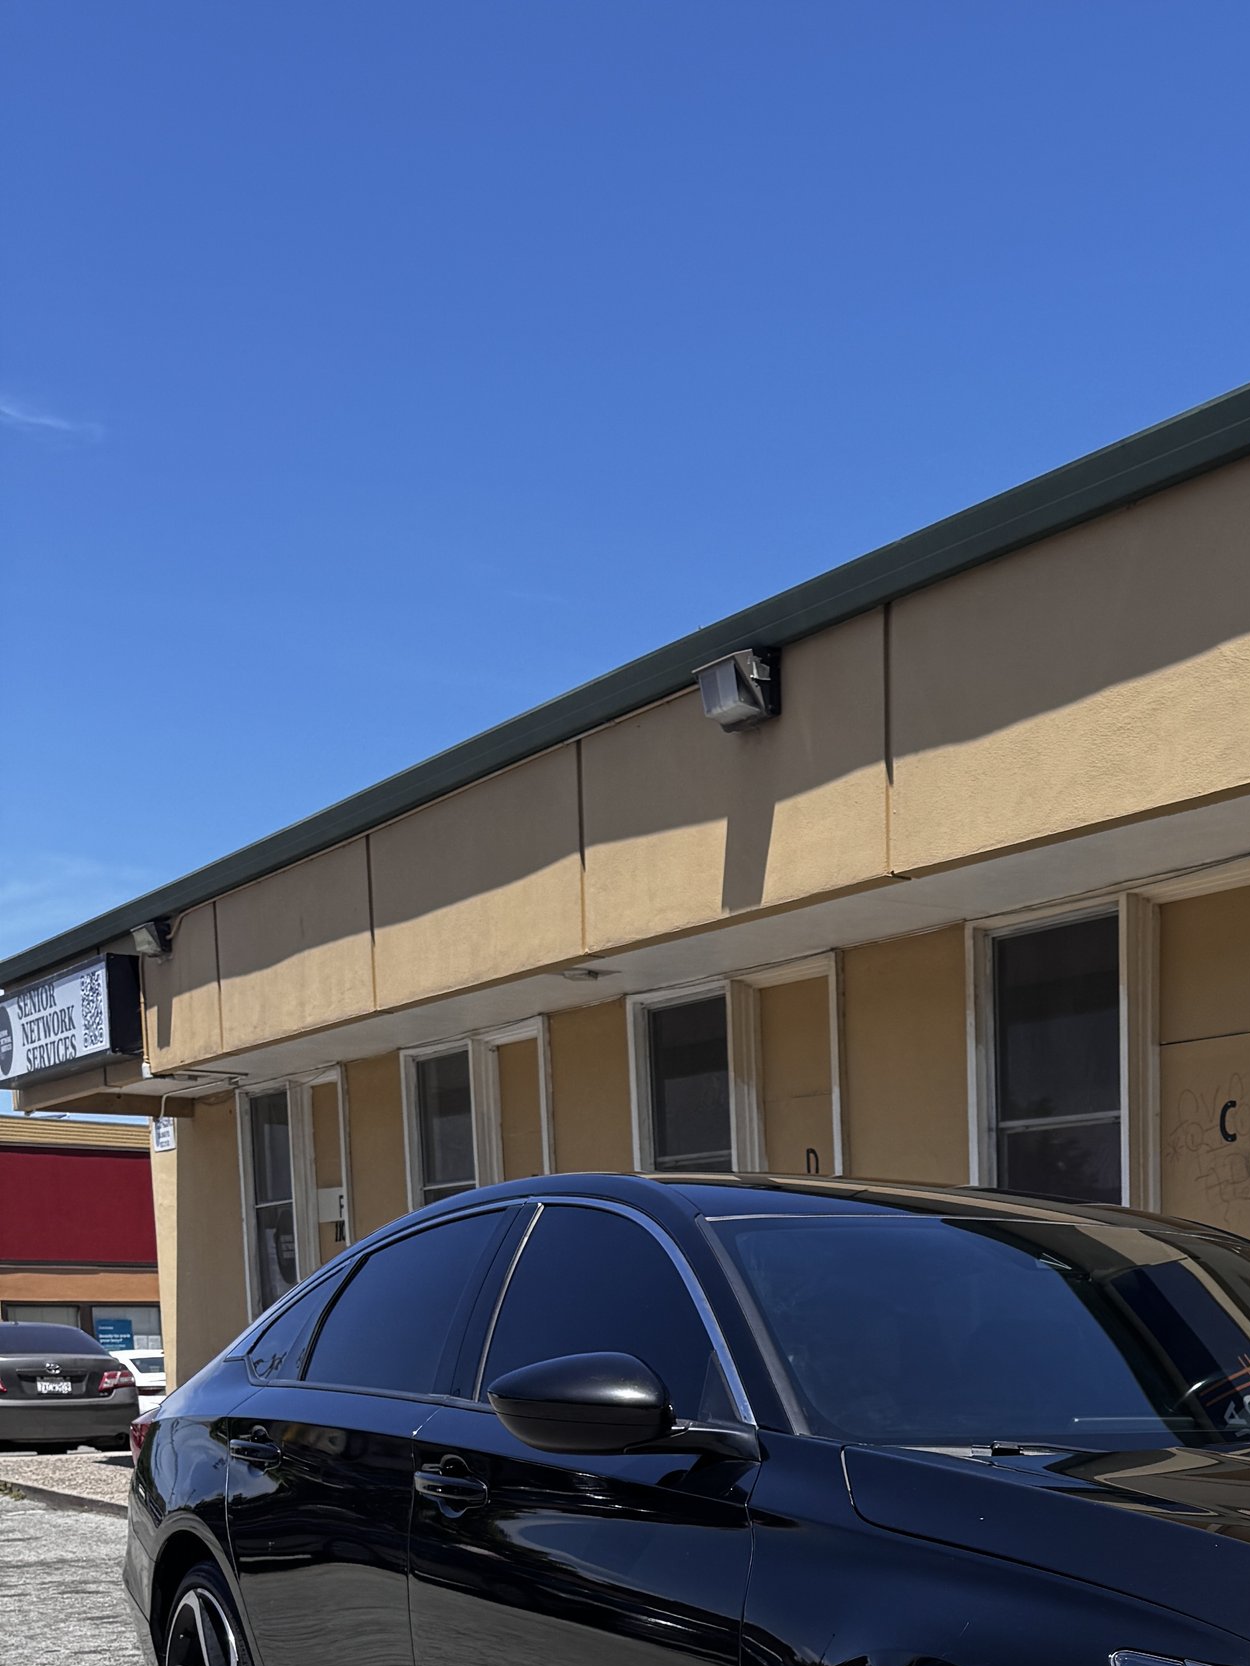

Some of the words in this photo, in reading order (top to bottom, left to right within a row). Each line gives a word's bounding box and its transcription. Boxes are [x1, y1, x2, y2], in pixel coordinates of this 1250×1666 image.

[16, 981, 57, 1021] SENIOR
[21, 1004, 76, 1048] NETWORK
[26, 1033, 77, 1073] SERVICES
[1219, 1100, 1237, 1142] C
